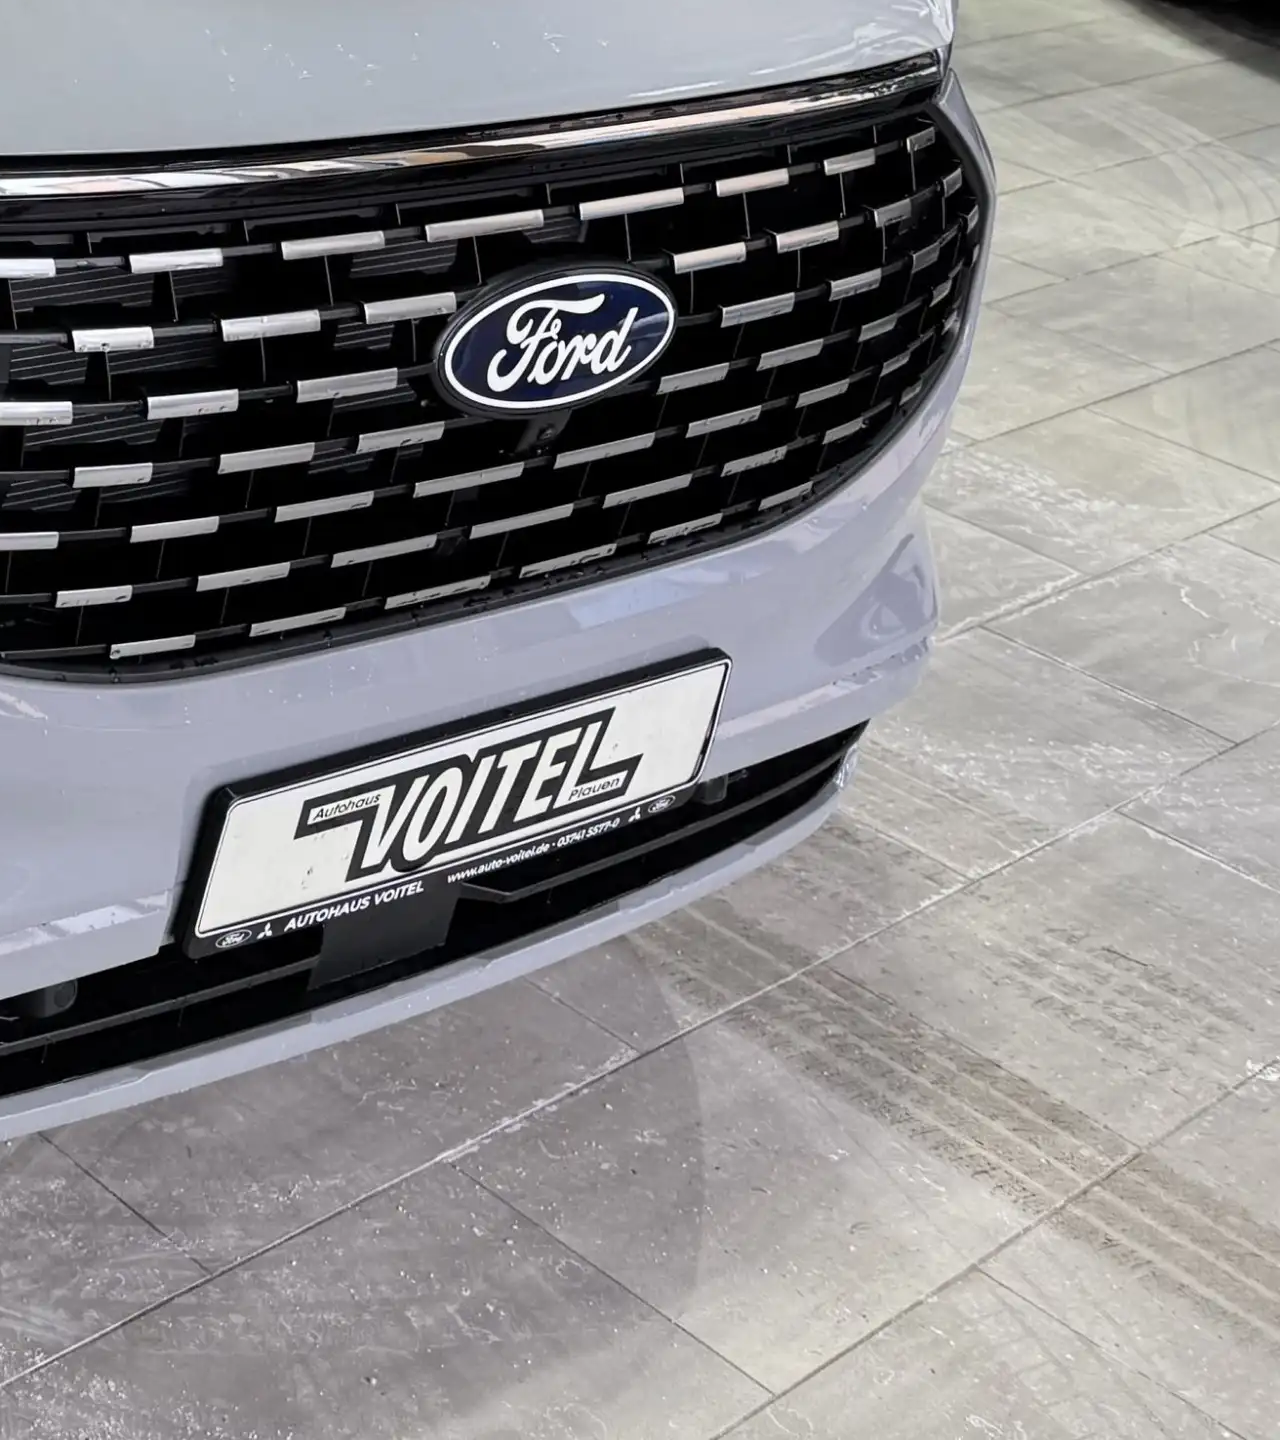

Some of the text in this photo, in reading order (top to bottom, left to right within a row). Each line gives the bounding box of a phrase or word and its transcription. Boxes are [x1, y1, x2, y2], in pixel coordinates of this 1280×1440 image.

[486, 293, 639, 392] Ford
[313, 791, 382, 822] Autohaus
[354, 720, 628, 870] VOITEL
[568, 775, 621, 802] Plauen
[446, 842, 550, 884] www.auto-voitel.de
[284, 895, 371, 933] AUTOHAUS
[373, 880, 425, 906] VOITEL
